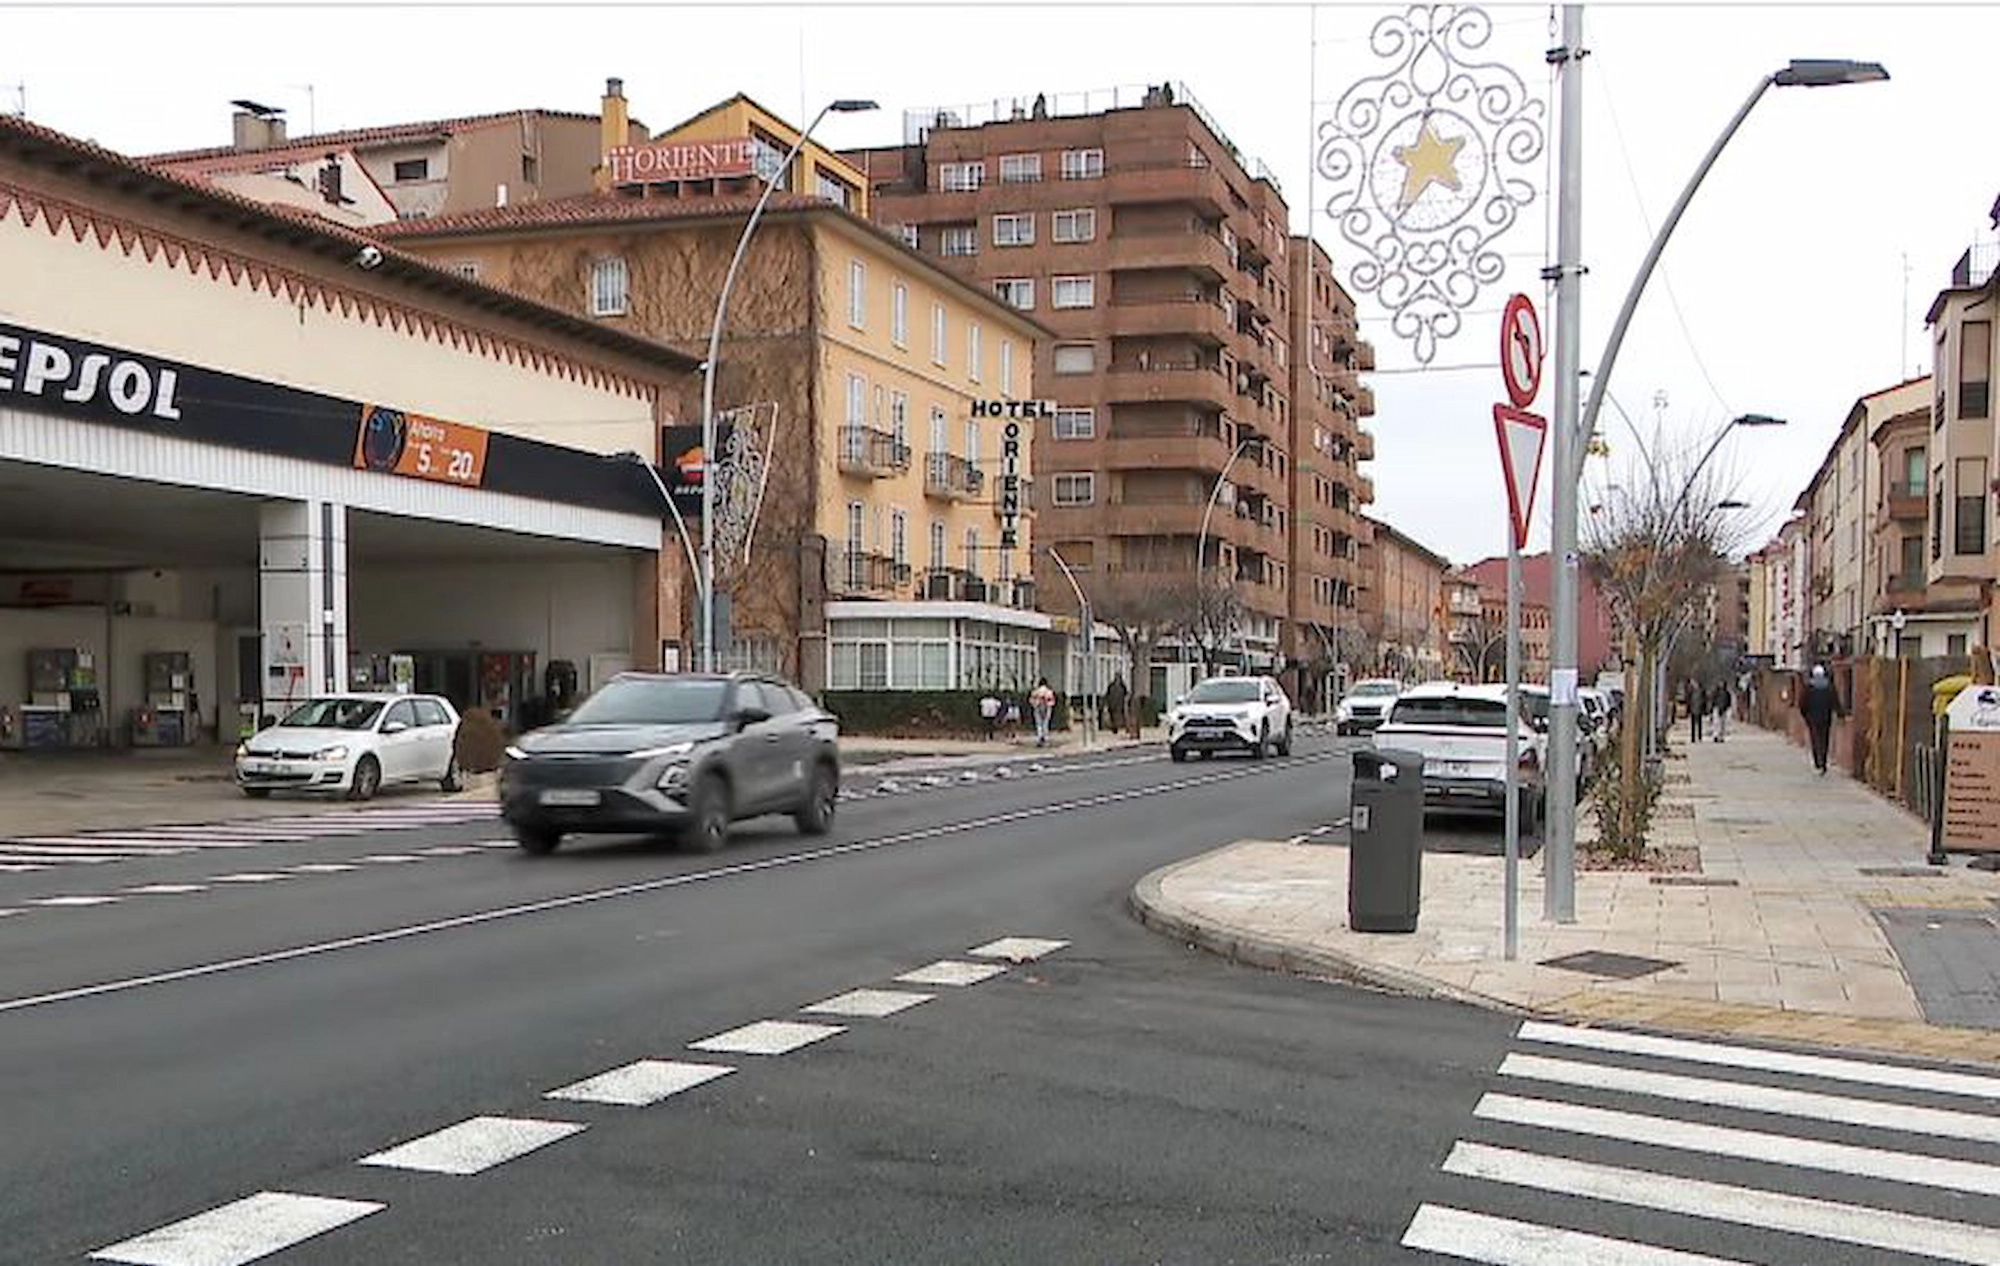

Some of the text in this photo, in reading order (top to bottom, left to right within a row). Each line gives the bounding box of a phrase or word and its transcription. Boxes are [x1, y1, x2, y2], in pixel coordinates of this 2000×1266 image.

[635, 141, 752, 172] ORIENTE
[971, 399, 1054, 417] HOTEL
[416, 442, 432, 474] 5
[448, 448, 474, 480] 20
[1002, 423, 1020, 546] ORIENTE
